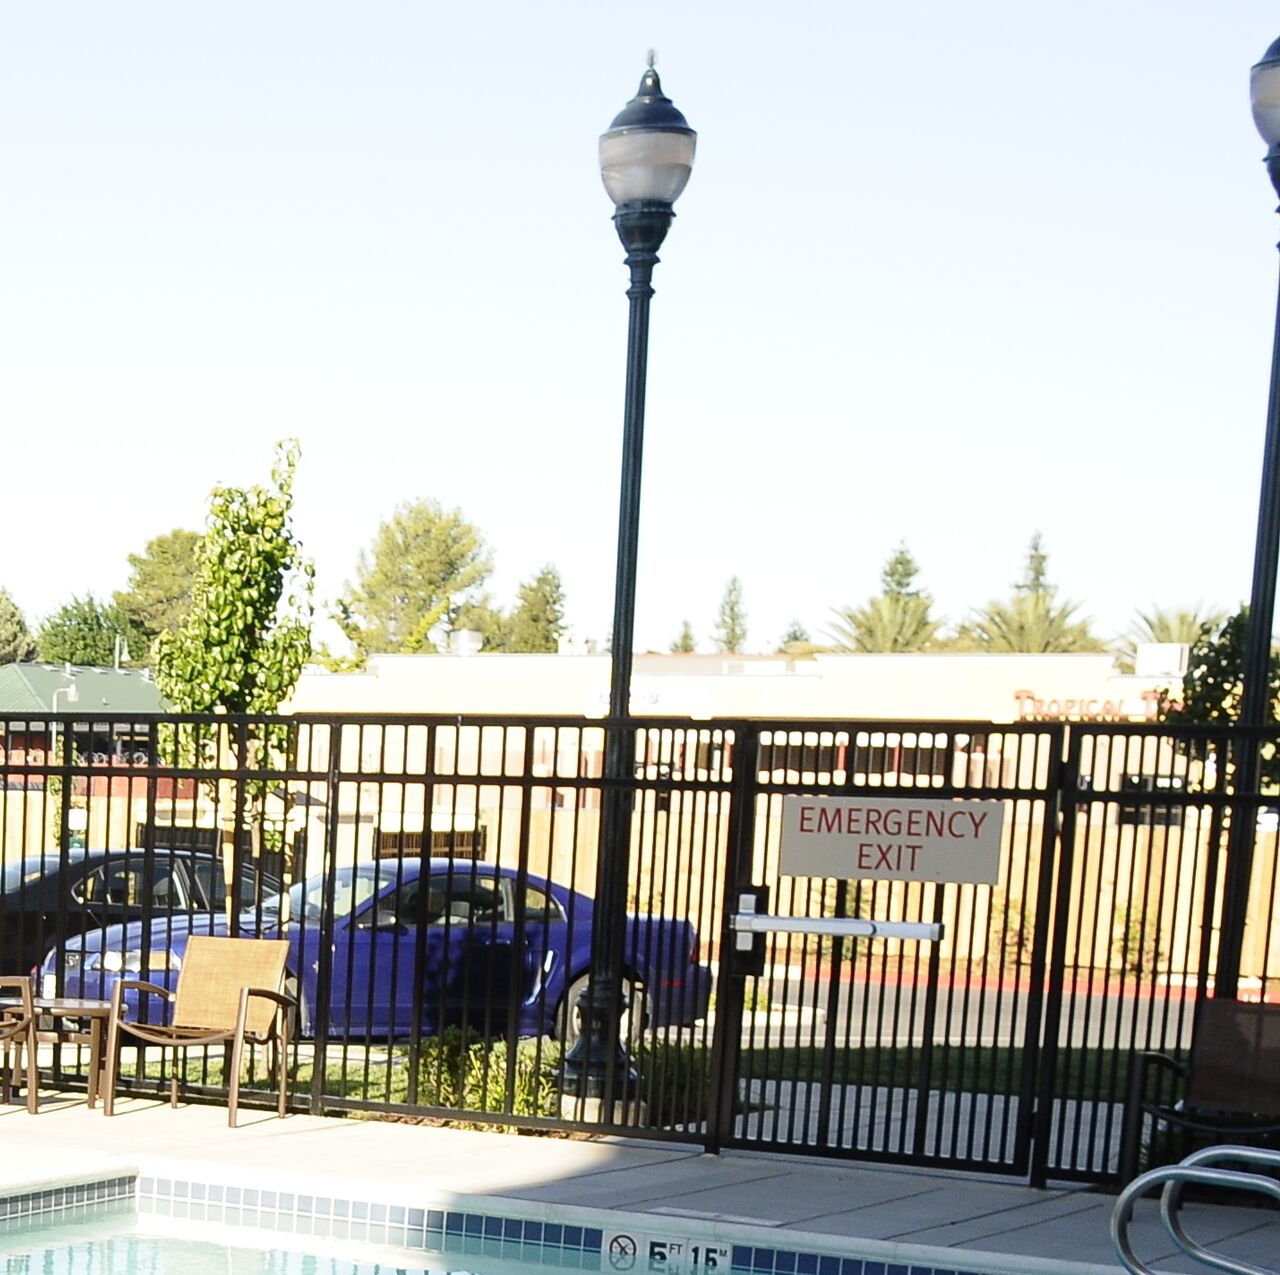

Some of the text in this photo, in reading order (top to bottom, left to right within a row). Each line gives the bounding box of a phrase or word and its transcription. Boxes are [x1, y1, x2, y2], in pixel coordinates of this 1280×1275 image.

[799, 806, 988, 838] EMERGENCY
[857, 843, 923, 871] EXIT
[669, 1243, 682, 1255] FT
[719, 1249, 727, 1257] M
